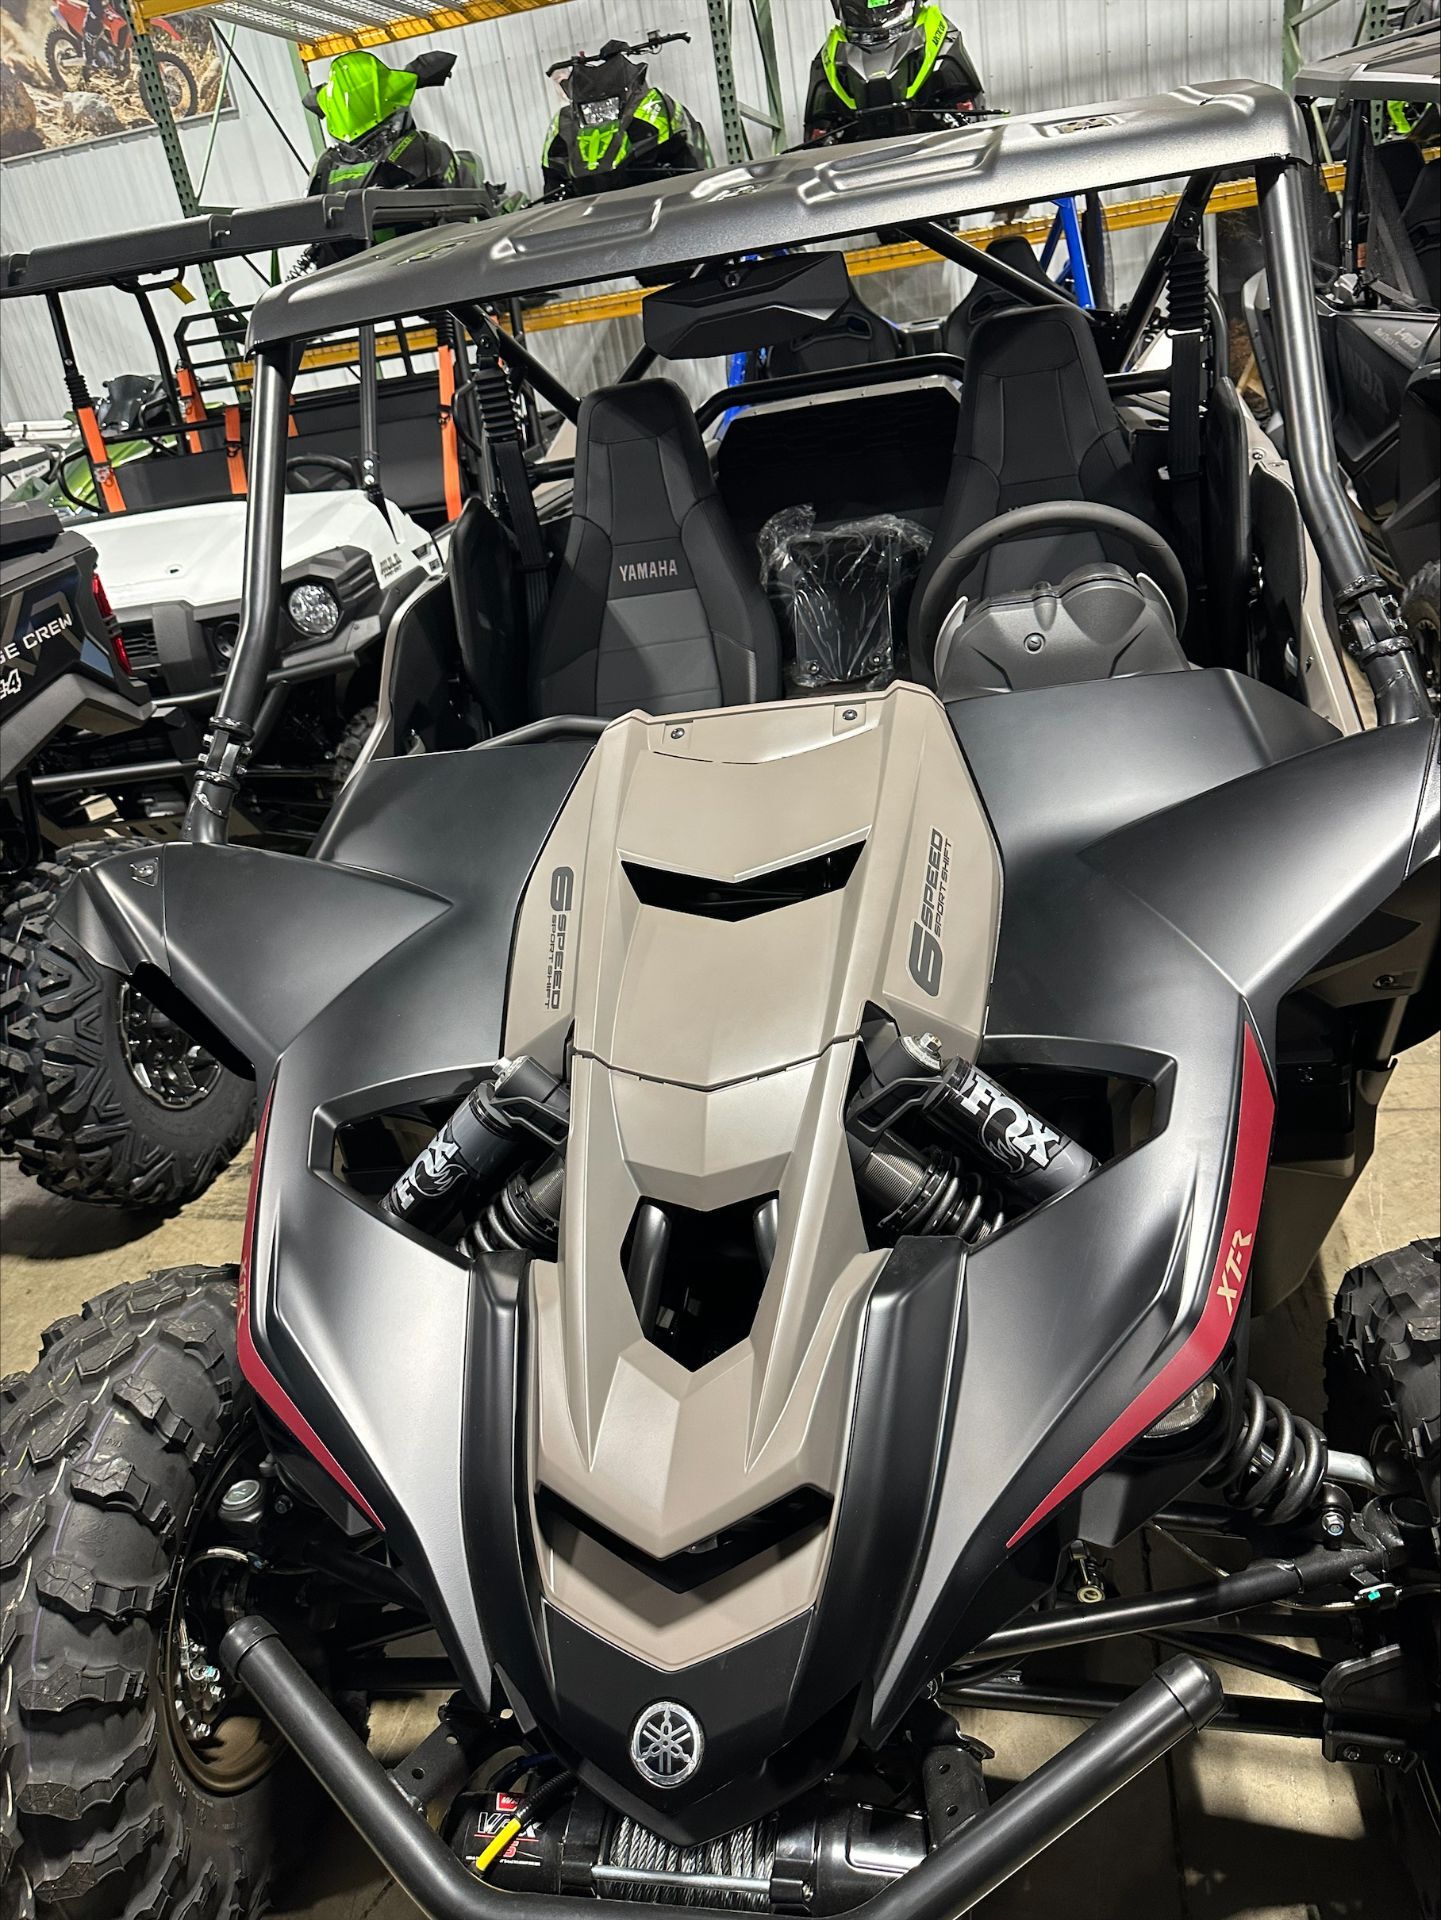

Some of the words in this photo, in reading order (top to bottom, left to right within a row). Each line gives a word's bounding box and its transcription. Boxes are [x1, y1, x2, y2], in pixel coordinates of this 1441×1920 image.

[619, 559, 679, 582] YAMAHA
[22, 613, 73, 650] CREW
[940, 838, 953, 884] SHIFT
[934, 881, 947, 938] SPORT
[548, 914, 558, 964] SPORT
[544, 964, 553, 1010] SHIFT
[960, 1074, 1061, 1170] FOX
[395, 1123, 465, 1210] FOX
[1216, 1229, 1253, 1317] XT-R
